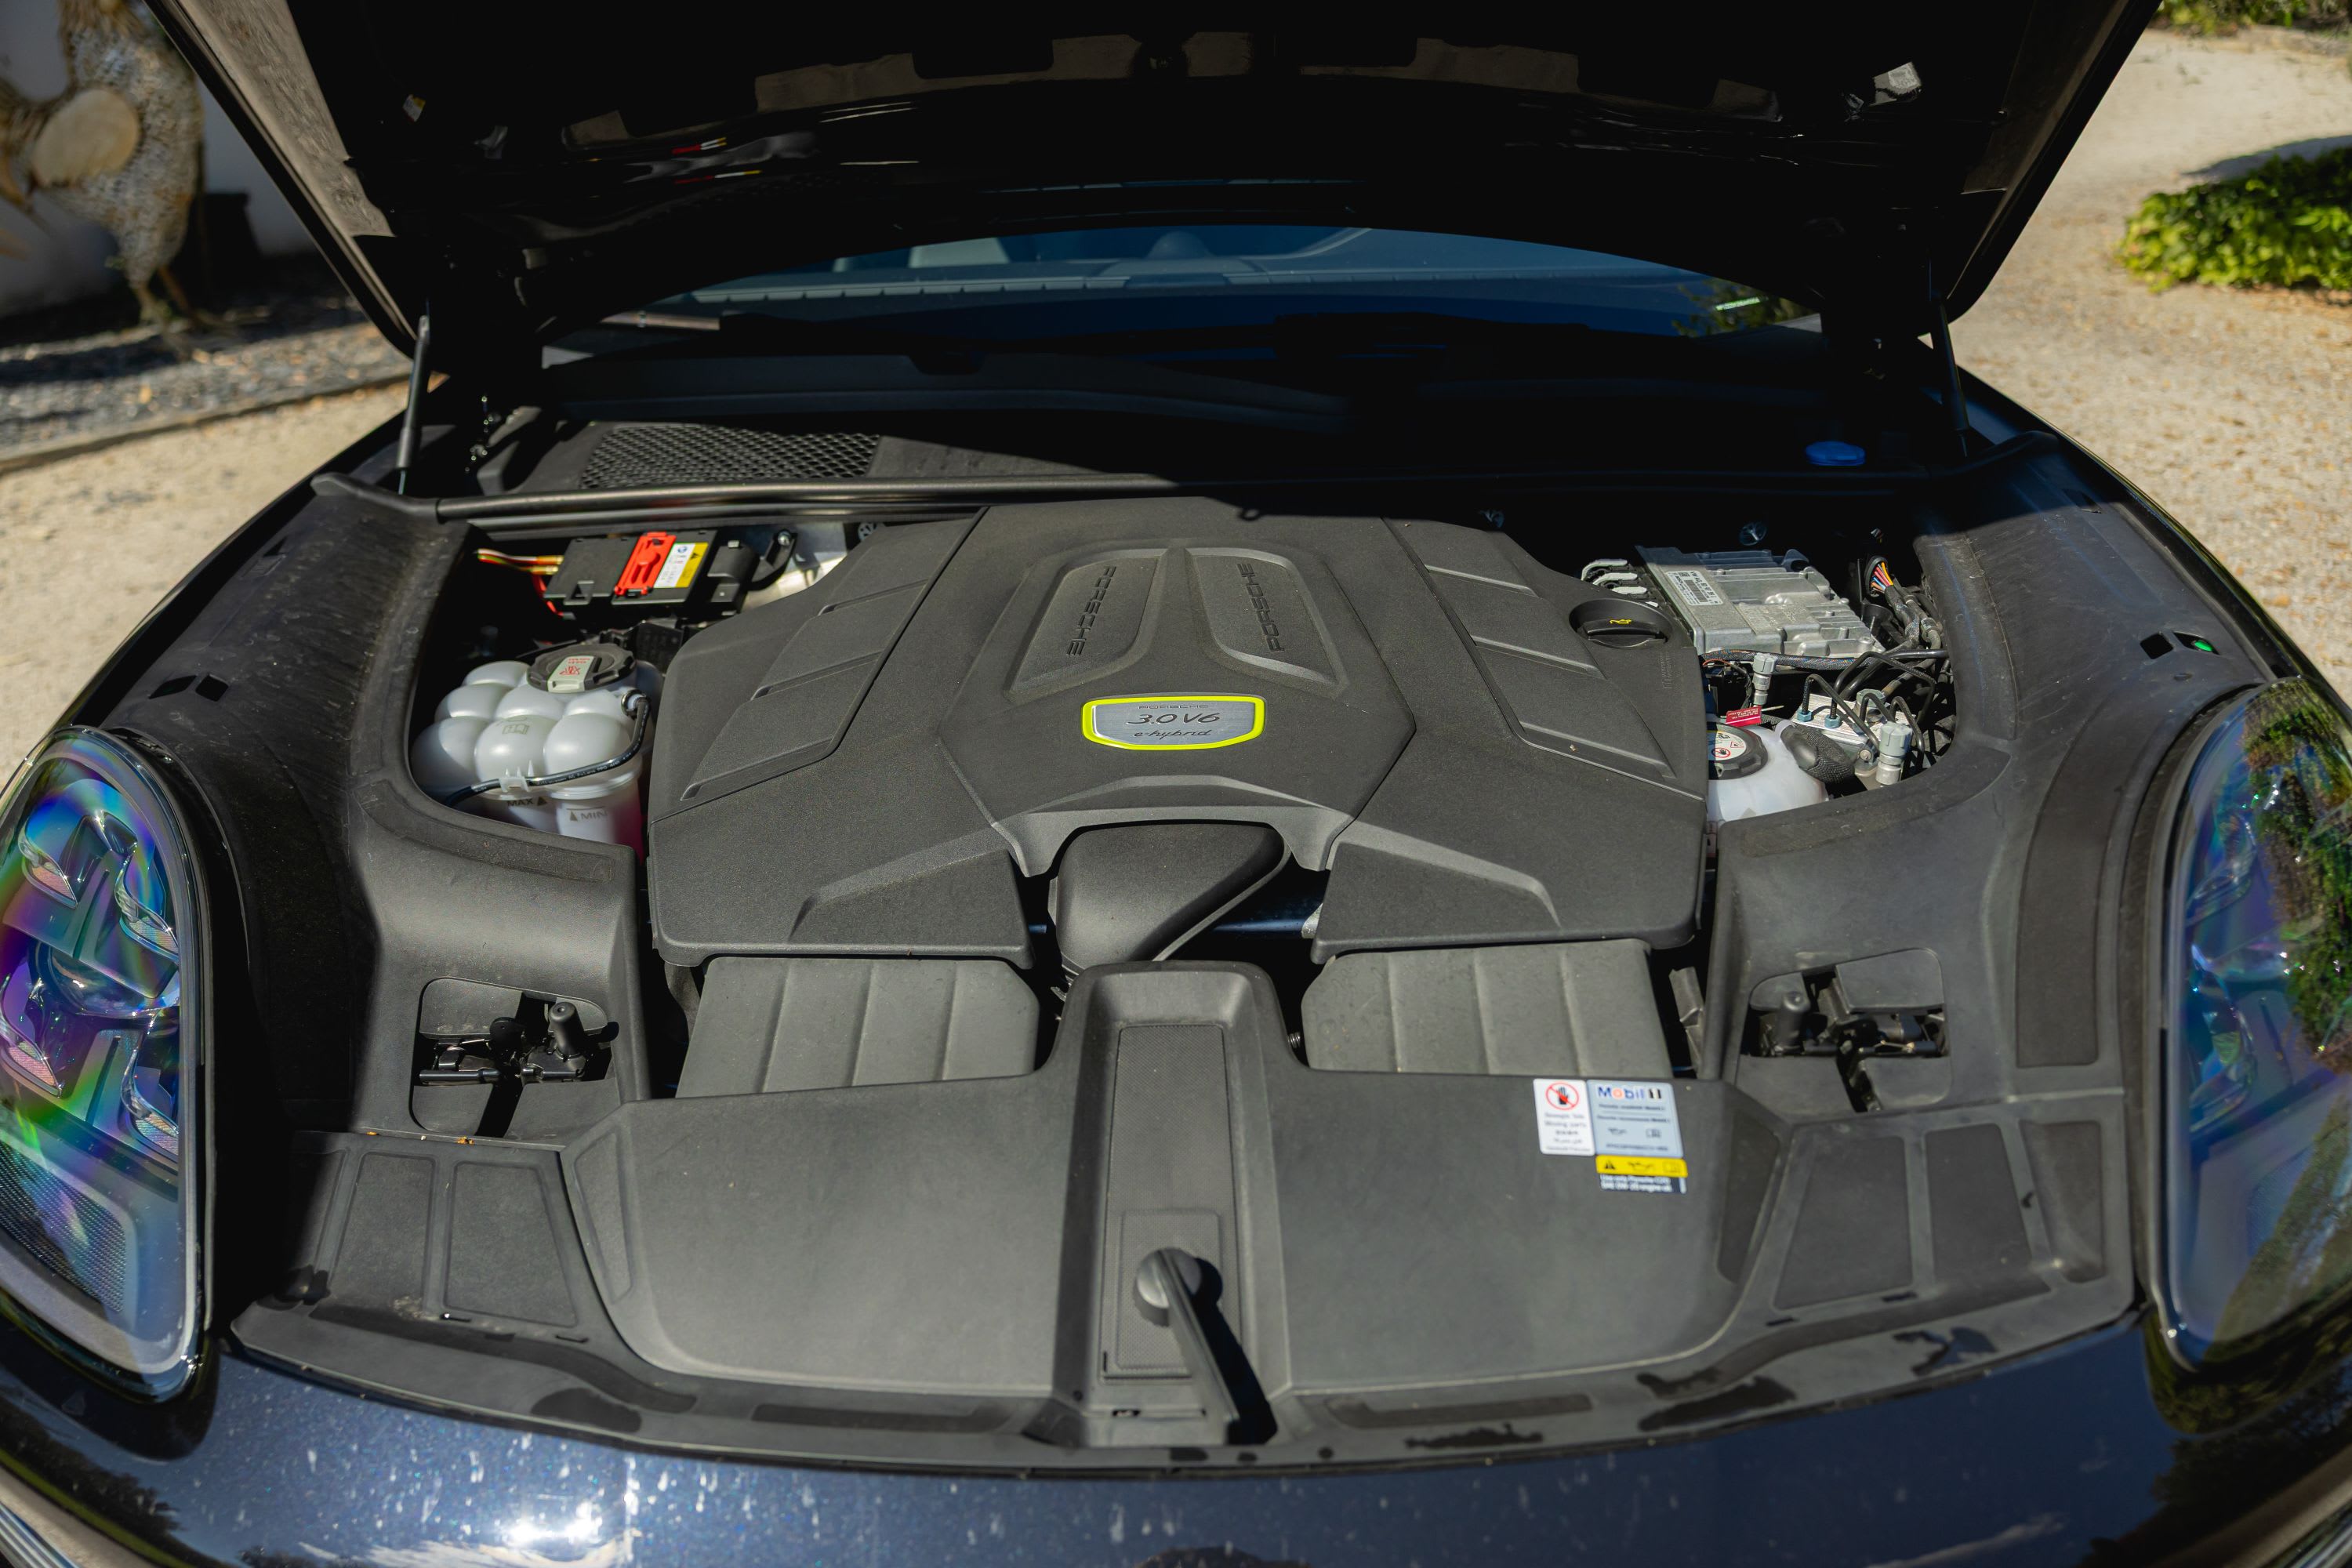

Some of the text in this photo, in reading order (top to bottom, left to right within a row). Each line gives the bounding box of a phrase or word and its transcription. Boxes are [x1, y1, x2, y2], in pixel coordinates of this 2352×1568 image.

[1066, 565, 1117, 656] PORSCHE
[1236, 563, 1285, 652] PORSCHE
[1126, 713, 1221, 724] 3.0 V6
[1134, 729, 1213, 740] e-hybrid
[580, 811, 608, 820] MIN
[1598, 1086, 1644, 1099] Mobil
